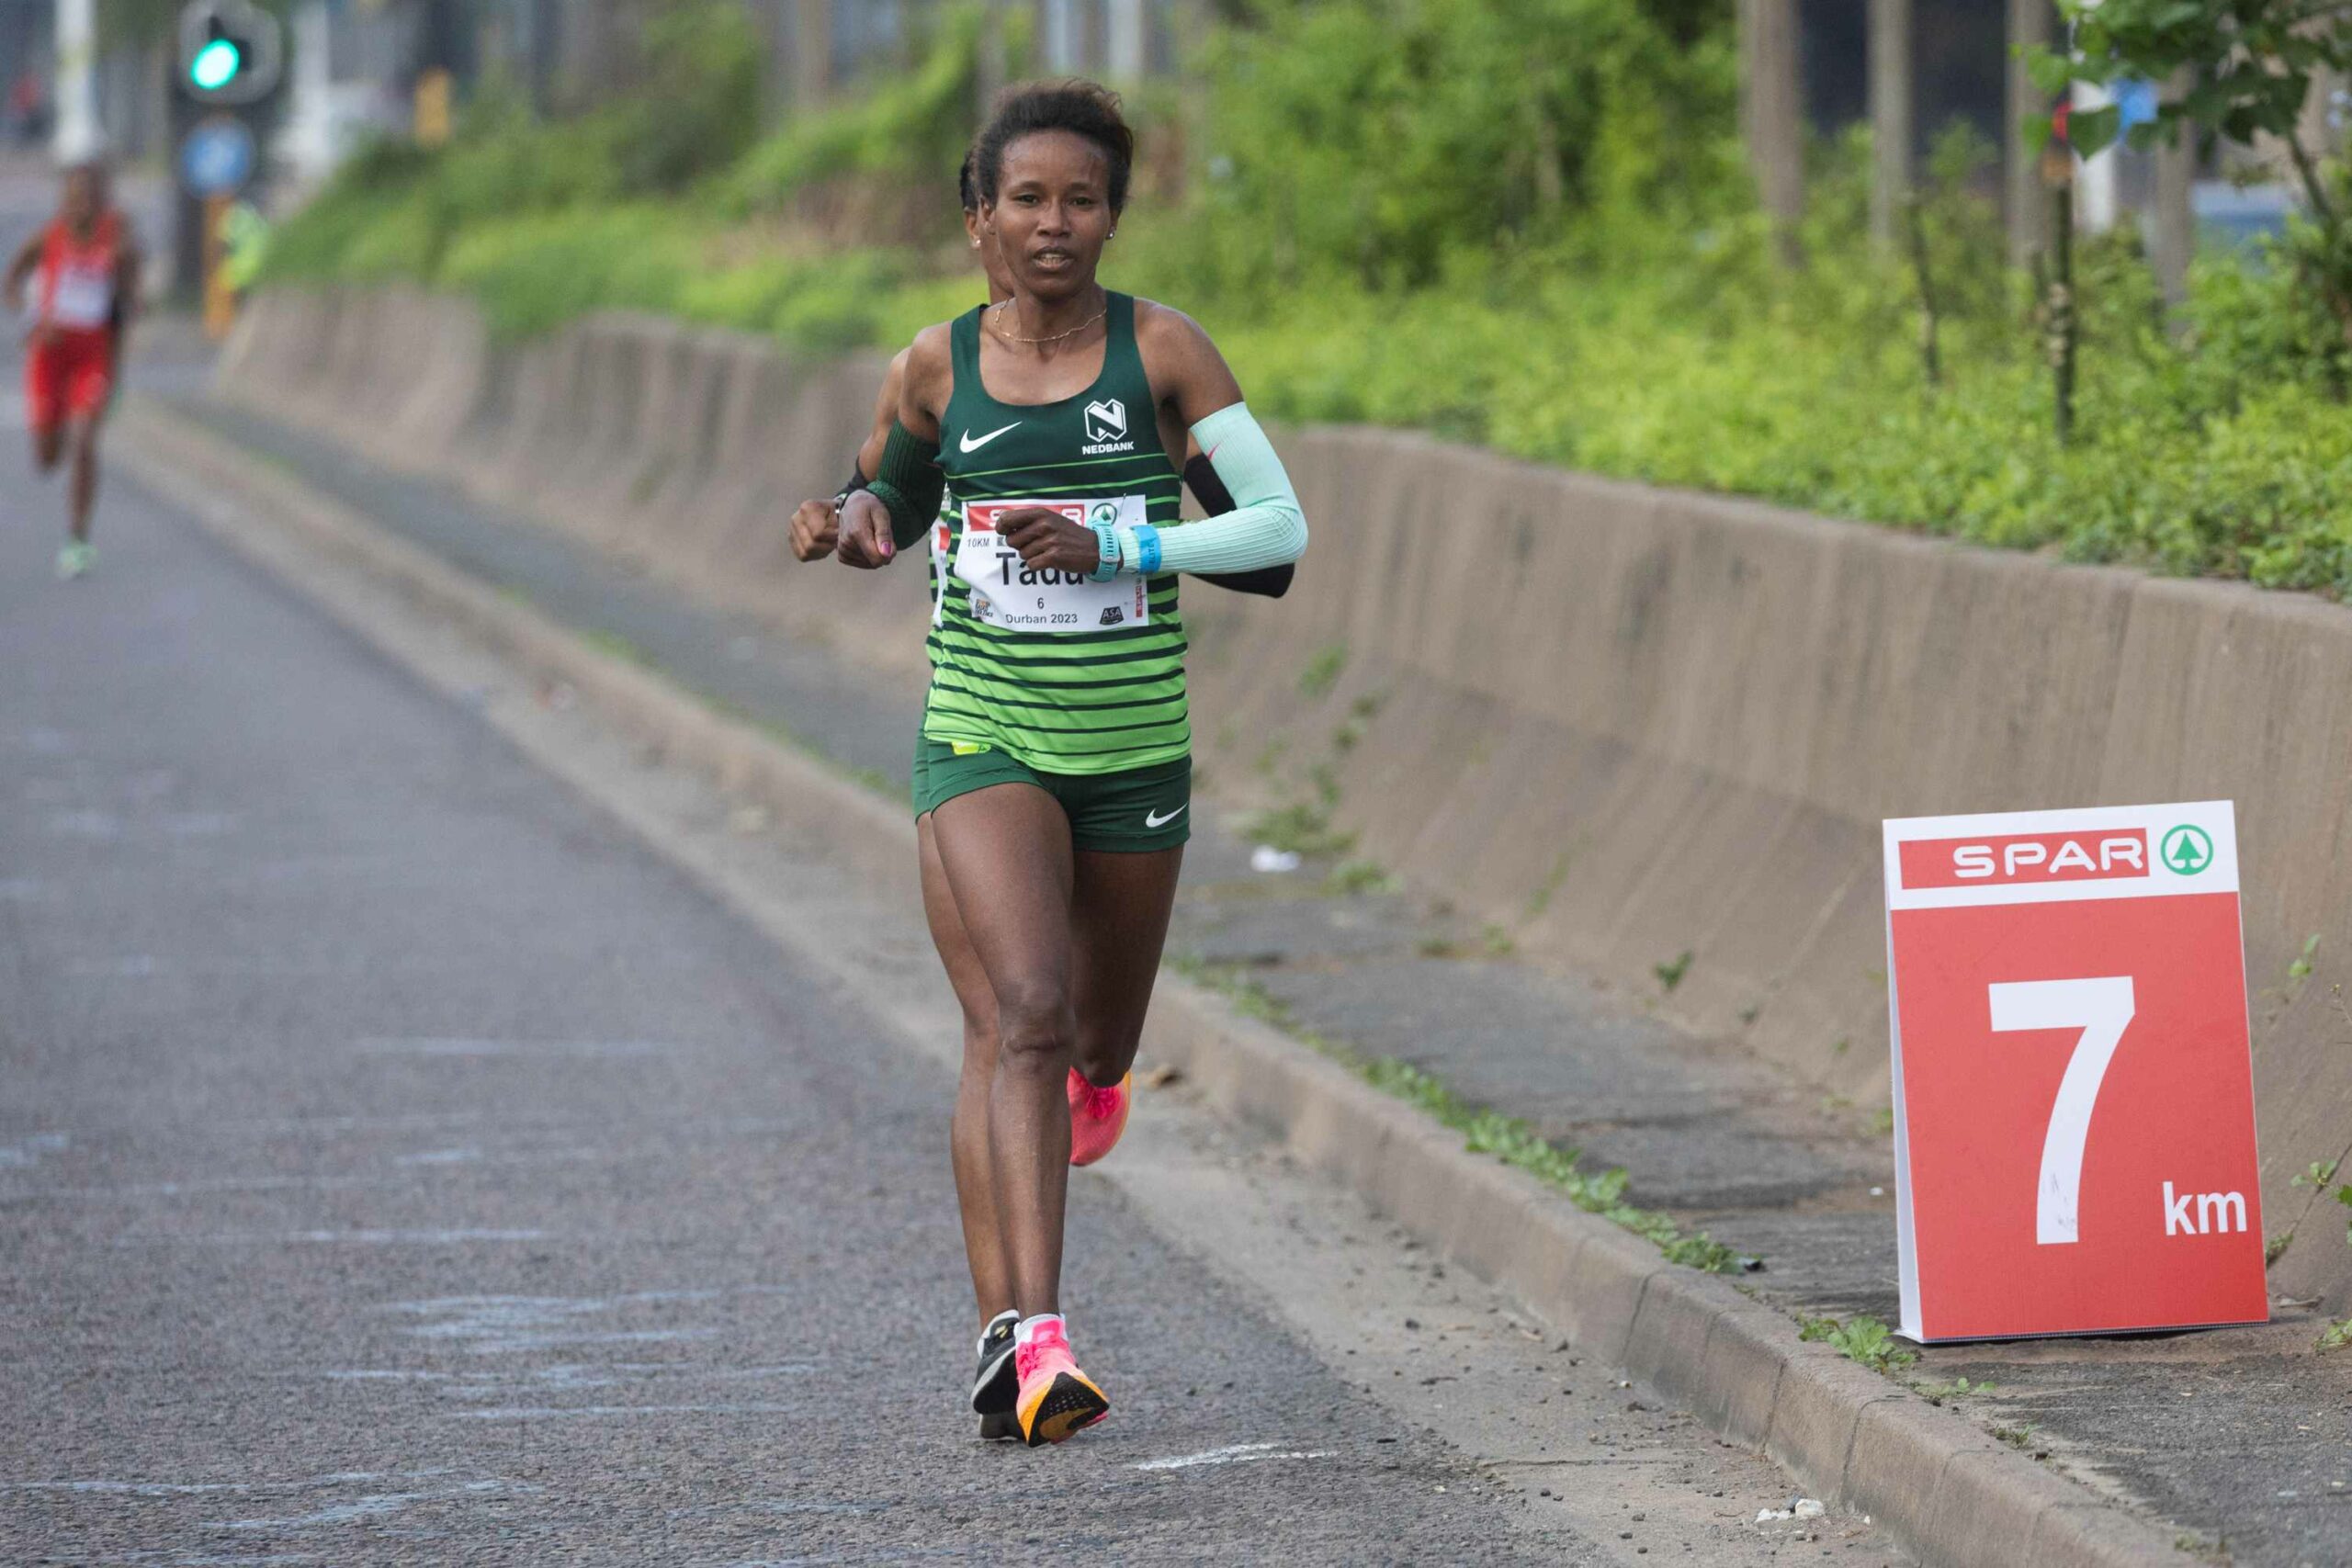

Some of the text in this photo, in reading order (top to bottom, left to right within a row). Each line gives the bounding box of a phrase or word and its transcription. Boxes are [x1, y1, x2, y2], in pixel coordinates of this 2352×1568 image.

[1081, 441, 1135, 455] NEDBANK
[989, 508, 1082, 527] SR
[967, 537, 990, 547] 10KM
[1037, 597, 1045, 610] 6
[1005, 613, 1079, 624] Durban 2023
[1102, 608, 1121, 618] ASA
[1952, 837, 2143, 878] SPAR
[1988, 976, 2247, 1245] 7 km
